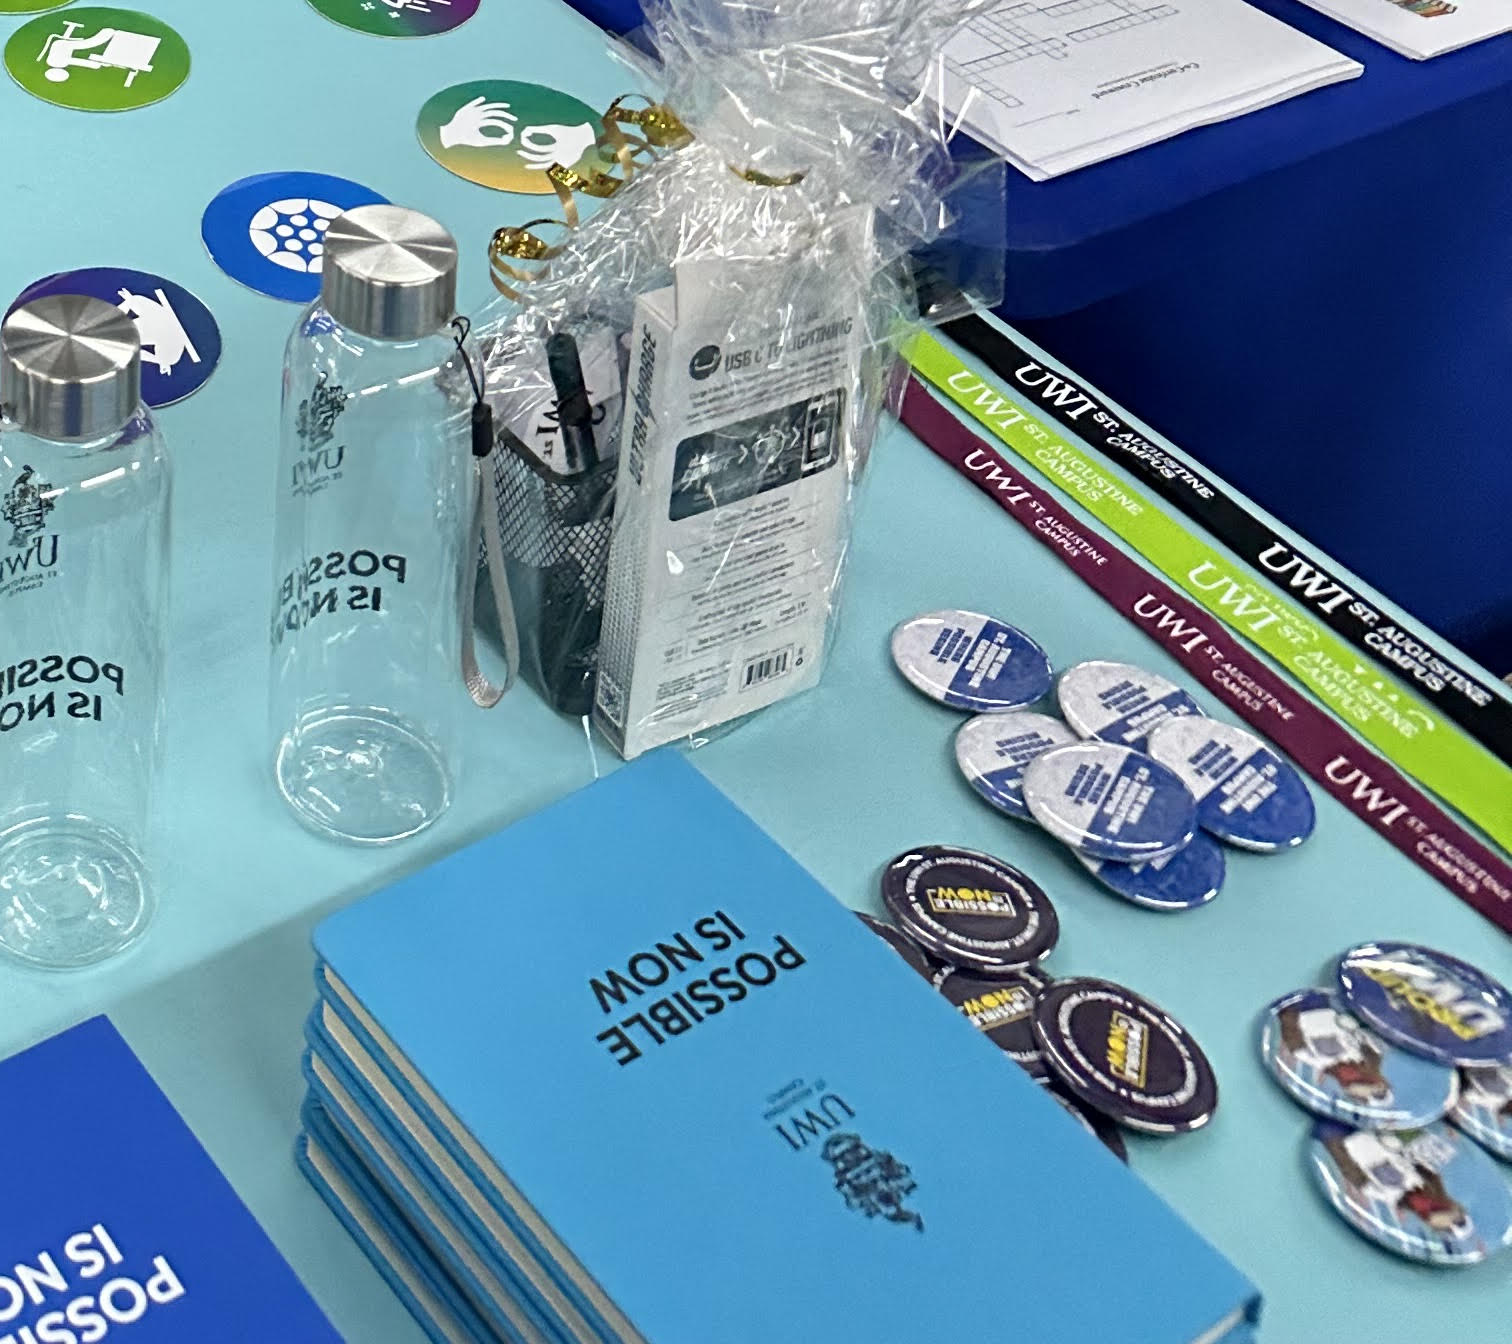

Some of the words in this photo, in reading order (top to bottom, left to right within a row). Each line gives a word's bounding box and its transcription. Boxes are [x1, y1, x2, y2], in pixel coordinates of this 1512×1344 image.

[725, 350, 752, 372] USB
[946, 370, 1026, 430] UWI
[1023, 423, 1049, 445] ST.
[1048, 444, 1144, 516] AUGUSTINE
[1014, 362, 1098, 420] UWI
[1093, 411, 1116, 433] ST.
[1119, 432, 1214, 500] AUGUSTINE
[1106, 435, 1178, 480] CAMPUS
[1034, 449, 1103, 502] CAMPUS
[964, 448, 1032, 506] UWI
[1043, 515, 1109, 566] AUGUSTINE
[1034, 519, 1080, 559] CAMPUS
[1188, 560, 1281, 634] UWI
[1305, 650, 1420, 739] AUGUSTINE
[1258, 541, 1355, 615] UWI
[1348, 602, 1380, 627] ST.
[1377, 625, 1492, 708] AUGUSTINE
[1132, 592, 1210, 654] UWI
[1223, 661, 1296, 721] AUGUSTINE
[1363, 632, 1447, 693] CAMPUS
[1212, 668, 1263, 713] CAMPUS
[1293, 654, 1370, 722] CAMPUS
[1324, 755, 1409, 827] UWI
[936, 886, 993, 901] NOW
[1415, 841, 1479, 895] CAMPUS
[694, 910, 746, 951] IS
[933, 897, 1009, 913] POSSIBLE
[589, 932, 705, 1014] NOW
[595, 934, 807, 1066] POSSIBLE
[963, 988, 1013, 1016] NOW
[775, 1092, 856, 1151] UWI
[64, 1223, 124, 1279] IS
